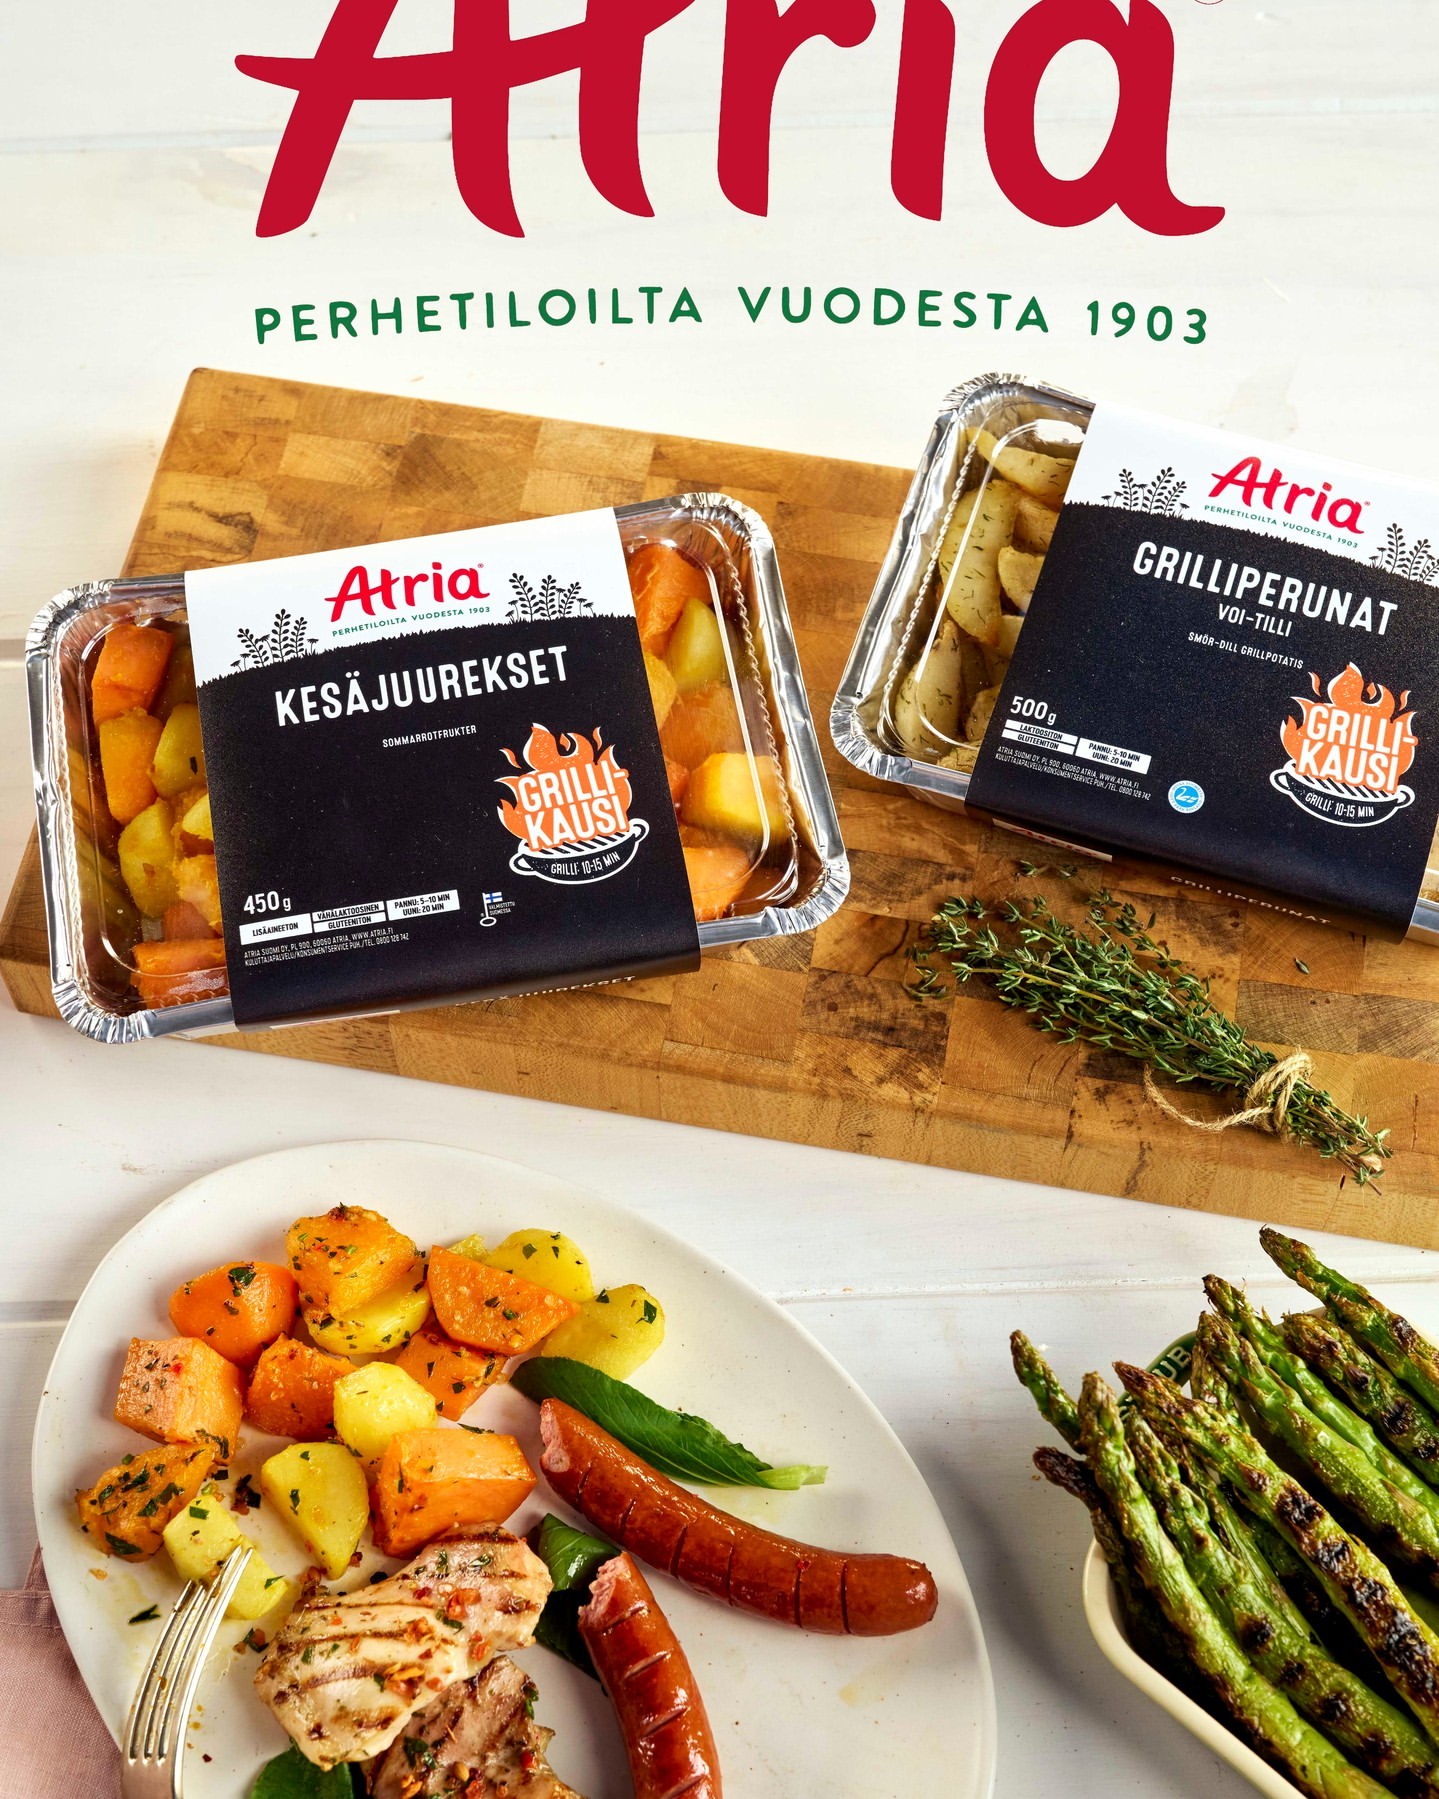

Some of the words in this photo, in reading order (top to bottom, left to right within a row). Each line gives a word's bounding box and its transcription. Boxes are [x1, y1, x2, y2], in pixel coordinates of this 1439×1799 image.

[1208, 456, 1366, 535] Atria
[1204, 504, 1277, 526] PERHETILOILTA
[1282, 520, 1333, 541] VUODESTA
[1337, 536, 1359, 549] 1903
[324, 562, 490, 623] Atria
[1132, 541, 1399, 636] GRILLIPERUNAT
[332, 616, 407, 637] PERHETILOILTA
[411, 608, 465, 623] VUODESTA
[468, 605, 491, 616] 1903
[1218, 602, 1293, 638] VOI-TILLI
[1188, 630, 1238, 654] SMÖR-DILL
[1240, 645, 1304, 670] GRILLPOTATIS
[275, 645, 568, 727] KESÄJUUREKSET
[1010, 695, 1049, 720] 500
[1047, 711, 1057, 726] g
[382, 724, 477, 748] SOMMARROTFRUKTER
[1017, 733, 1059, 750] GLUTEENITON
[1020, 724, 1063, 741] LAKTOOSITON
[1306, 705, 1416, 755] GRILLI-
[998, 746, 1014, 757] ATRIA
[1014, 750, 1031, 761] SUOMI
[1099, 772, 1140, 789] WWW.ATRIA.FI
[1088, 742, 1113, 755] PANNU:
[1113, 748, 1127, 759] 5-10
[1127, 752, 1140, 762] MIN
[1092, 752, 1110, 763] UUNI:
[1110, 756, 1119, 765] 20
[1119, 758, 1132, 768] MIN
[1298, 739, 1399, 791] KAUSI
[518, 760, 627, 812] GRILLI-
[1305, 792, 1333, 811] GRILLI:
[1335, 802, 1356, 817] 10-15
[1358, 806, 1374, 817] MIN
[524, 795, 627, 850] KAUSI
[550, 862, 580, 876] GRILLI:
[582, 858, 603, 874] 10-15
[603, 852, 621, 867] MIN
[243, 890, 281, 915] 450
[282, 897, 291, 912] g
[394, 899, 419, 910] PANNU:
[437, 893, 450, 902] MIN
[402, 906, 421, 916] UUNI:
[422, 904, 431, 913] 20
[431, 903, 445, 911] MIN
[252, 922, 299, 937] LISÄAINEETON
[328, 916, 372, 930] GLUTEENITON
[244, 949, 261, 959] ATRIA
[261, 946, 280, 956] SUOMI
[352, 927, 394, 941] WWW.ATRIA.FI
